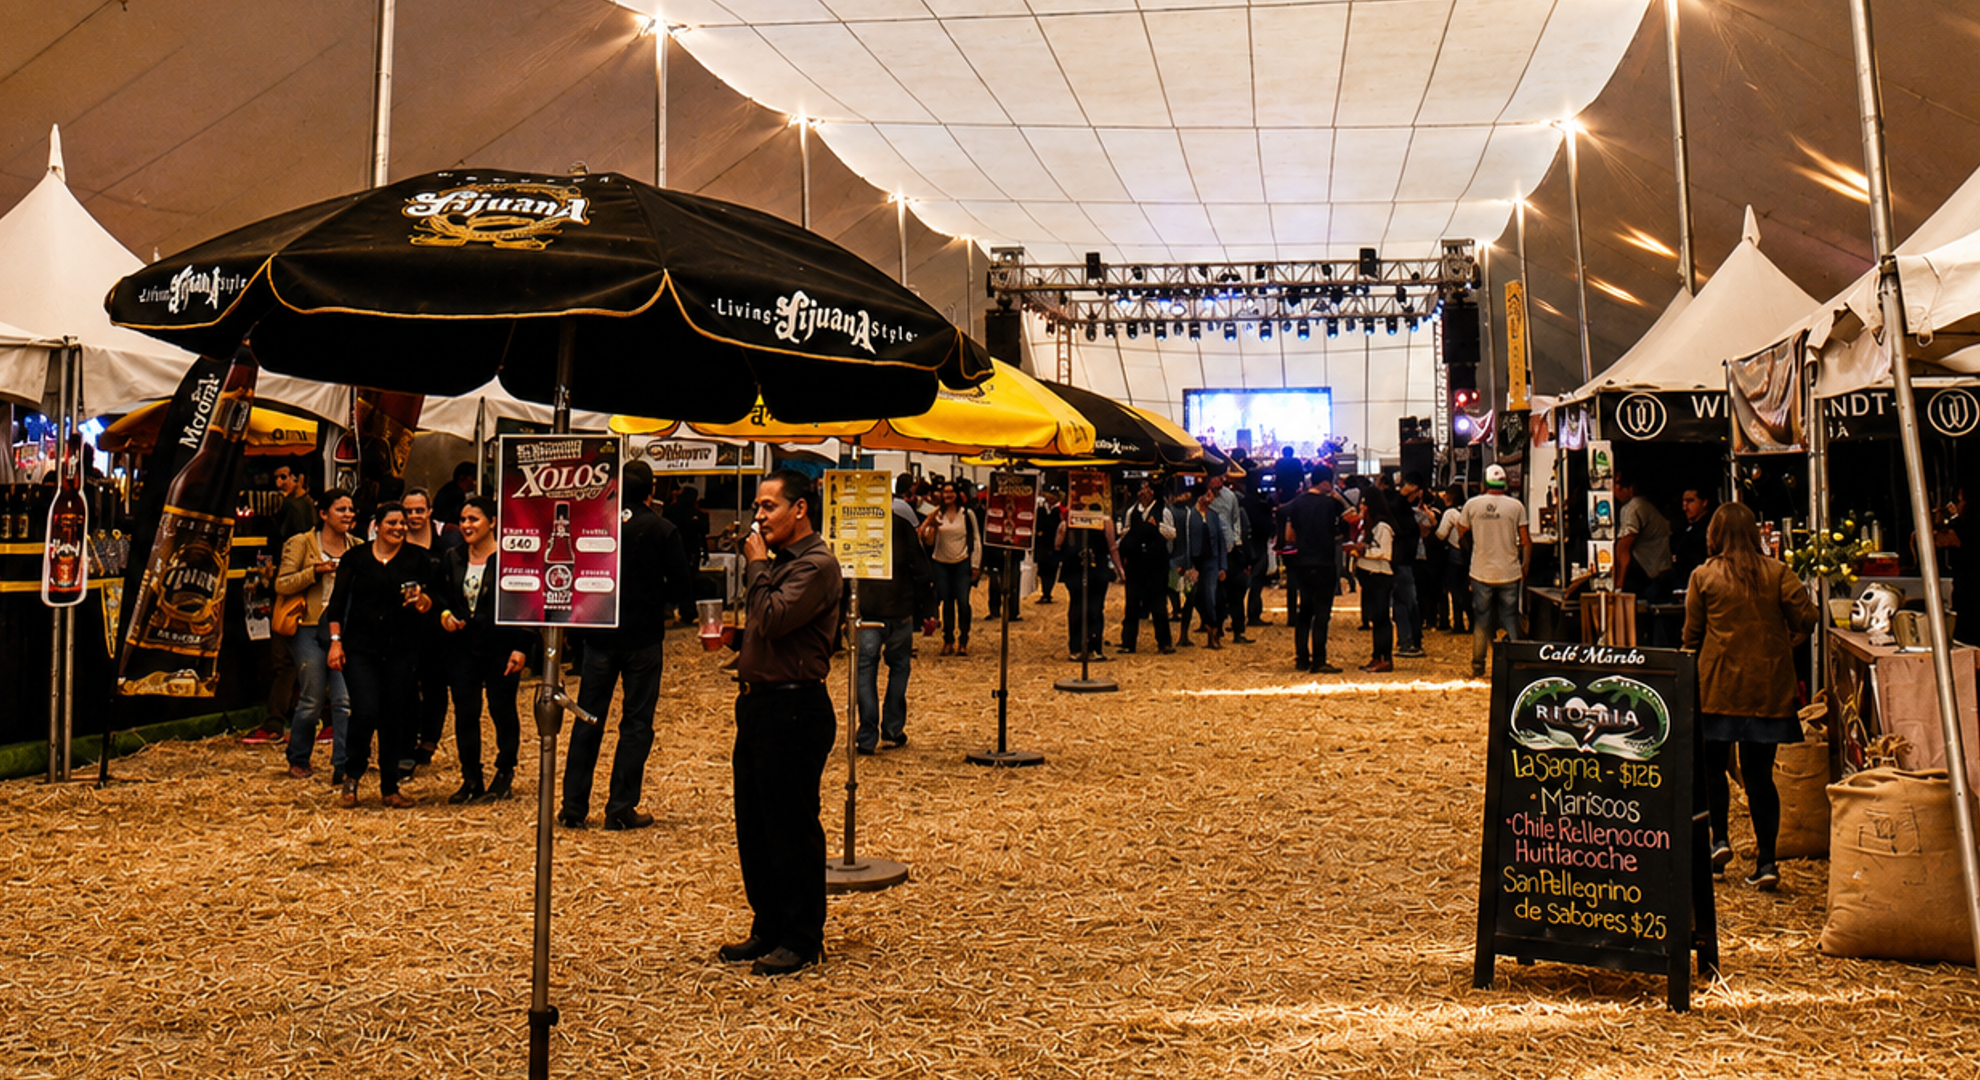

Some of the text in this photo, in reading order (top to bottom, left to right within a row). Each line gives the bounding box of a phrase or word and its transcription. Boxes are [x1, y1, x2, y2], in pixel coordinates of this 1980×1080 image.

[512, 462, 610, 498] XOLOS
[1540, 786, 1641, 823] Mariscos
[1512, 812, 1555, 839] Chile
[1515, 839, 1638, 872] Huitlacoche
[1514, 897, 1542, 921] de
[1631, 912, 1668, 940] $25
